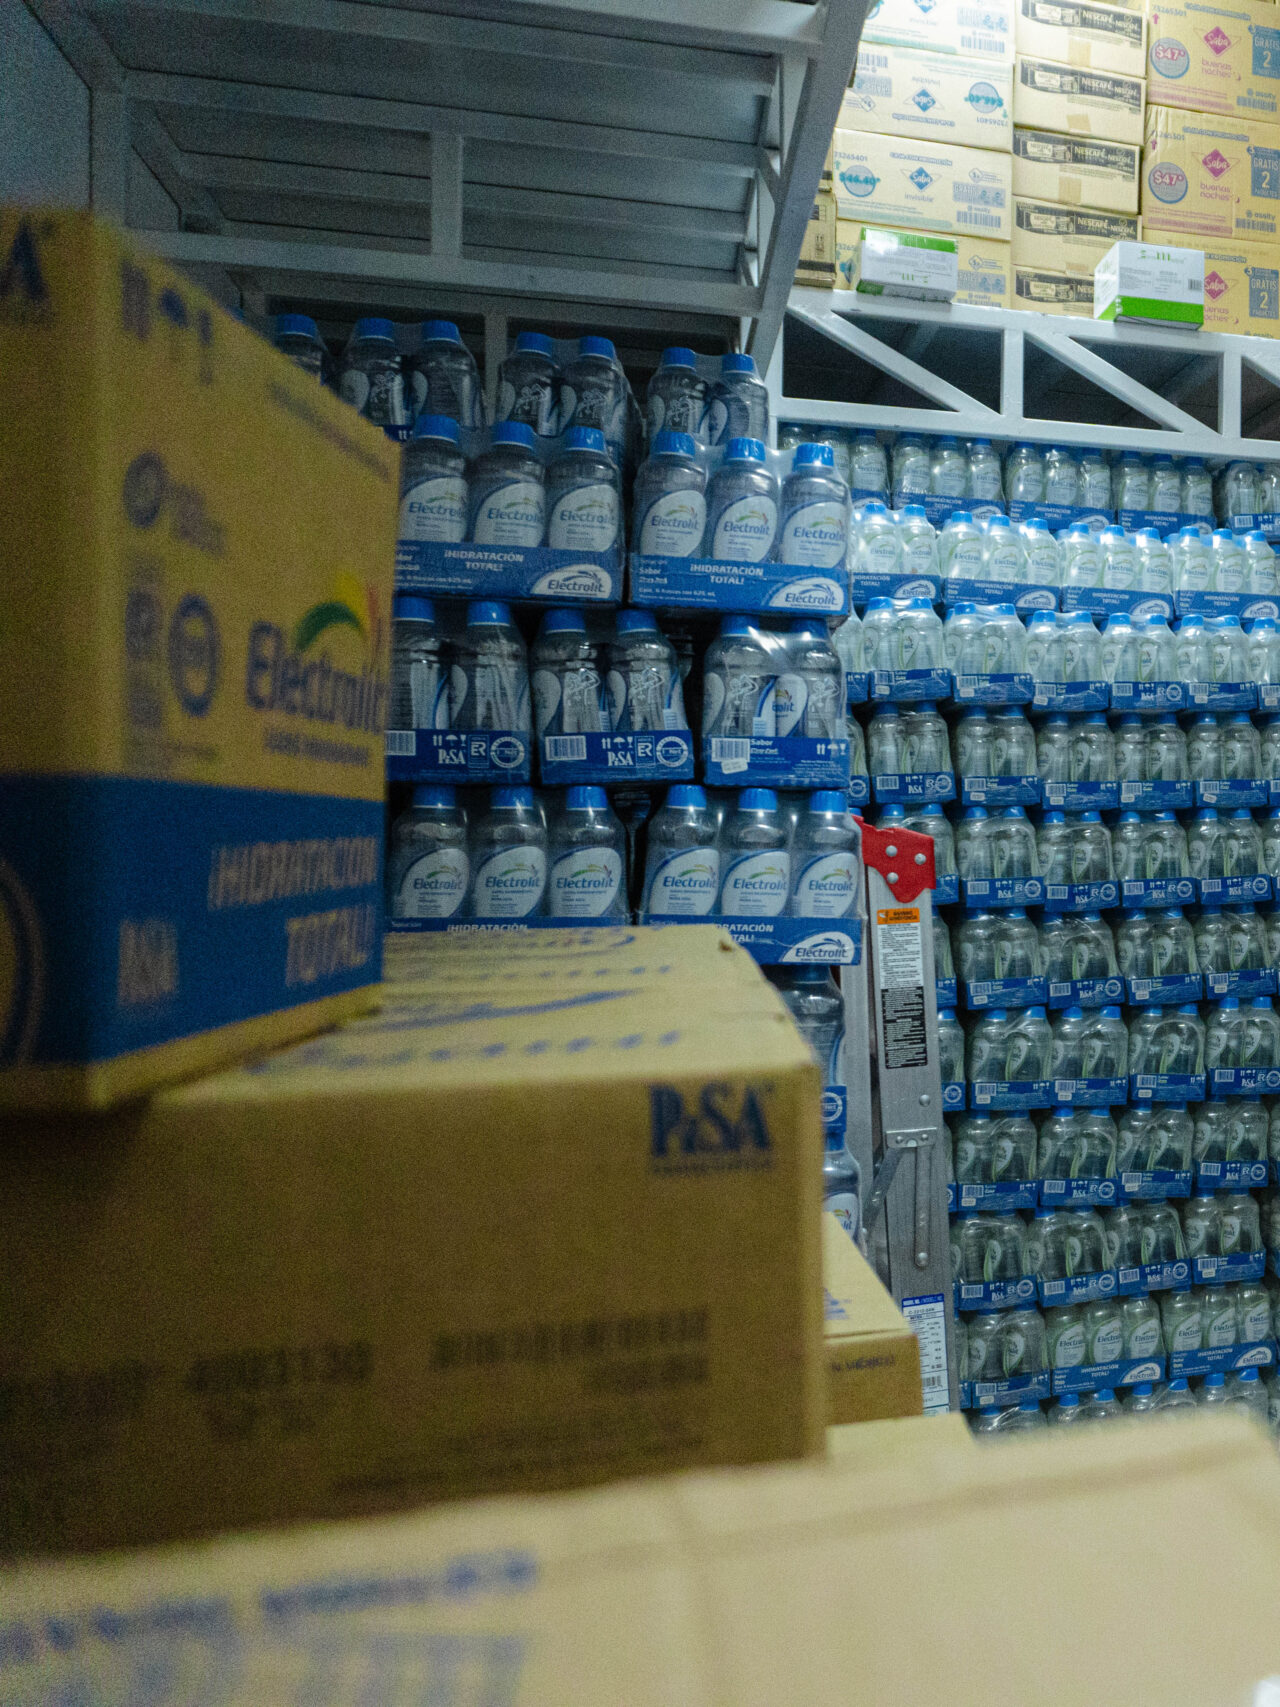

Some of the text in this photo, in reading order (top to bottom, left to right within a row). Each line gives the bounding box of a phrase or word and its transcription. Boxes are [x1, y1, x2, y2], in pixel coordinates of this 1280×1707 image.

[1263, 50, 1271, 67] 2
[1262, 171, 1271, 189] 2
[1251, 278, 1277, 290] GRATIS
[1260, 291, 1269, 309] 2
[651, 512, 699, 530] Electrolit
[723, 517, 770, 535] Electrolit
[793, 523, 846, 542] Electrolit
[443, 549, 525, 562] ¡HIDRATACIÓN
[465, 561, 503, 572] TOTAL!
[689, 563, 764, 577] ¡HIDRATACIÓN
[547, 577, 606, 593] Electrolit
[709, 575, 745, 585] TOTAL!
[785, 590, 838, 606] Electrolit
[470, 741, 487, 758] ER
[637, 742, 653, 758] ER
[751, 738, 773, 746] Sabor
[438, 748, 466, 765] PiSA
[607, 750, 634, 767] PiSA
[413, 875, 463, 890] Electrolit
[485, 873, 542, 889] Electrolit
[556, 874, 614, 890] Electrolit
[663, 874, 719, 890] Electrolit
[733, 876, 788, 892] Electrolit
[808, 878, 854, 893] Electrolit
[795, 946, 849, 959] Electrolit
[648, 1083, 775, 1162] PiSA
[1243, 1355, 1269, 1365] Electrolit
[1130, 1371, 1157, 1381] Electrolit
